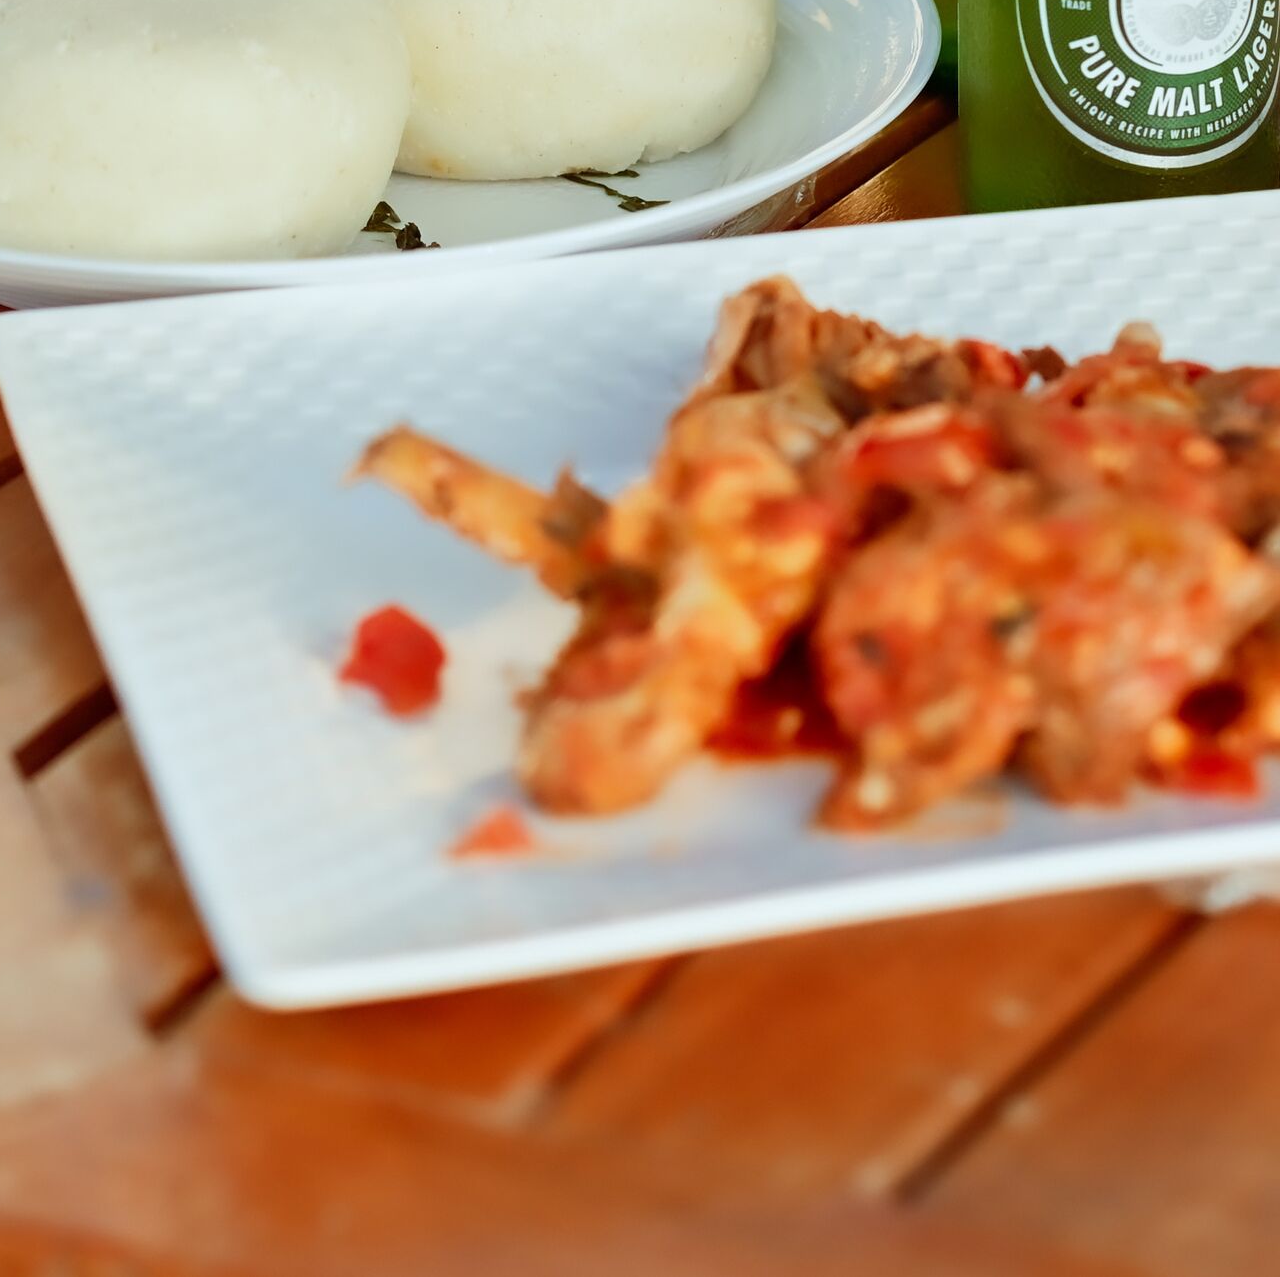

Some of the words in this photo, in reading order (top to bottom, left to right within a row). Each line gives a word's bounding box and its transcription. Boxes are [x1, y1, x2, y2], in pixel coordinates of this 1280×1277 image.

[1069, 35, 1141, 108] PURE
[1148, 77, 1224, 117] MALT
[1232, 0, 1277, 93] LAGER
[1069, 87, 1115, 126] UNIQUE
[1119, 121, 1164, 140] RECIPE
[1170, 128, 1201, 140] WITH
[1207, 99, 1255, 134] HEINEKEN
